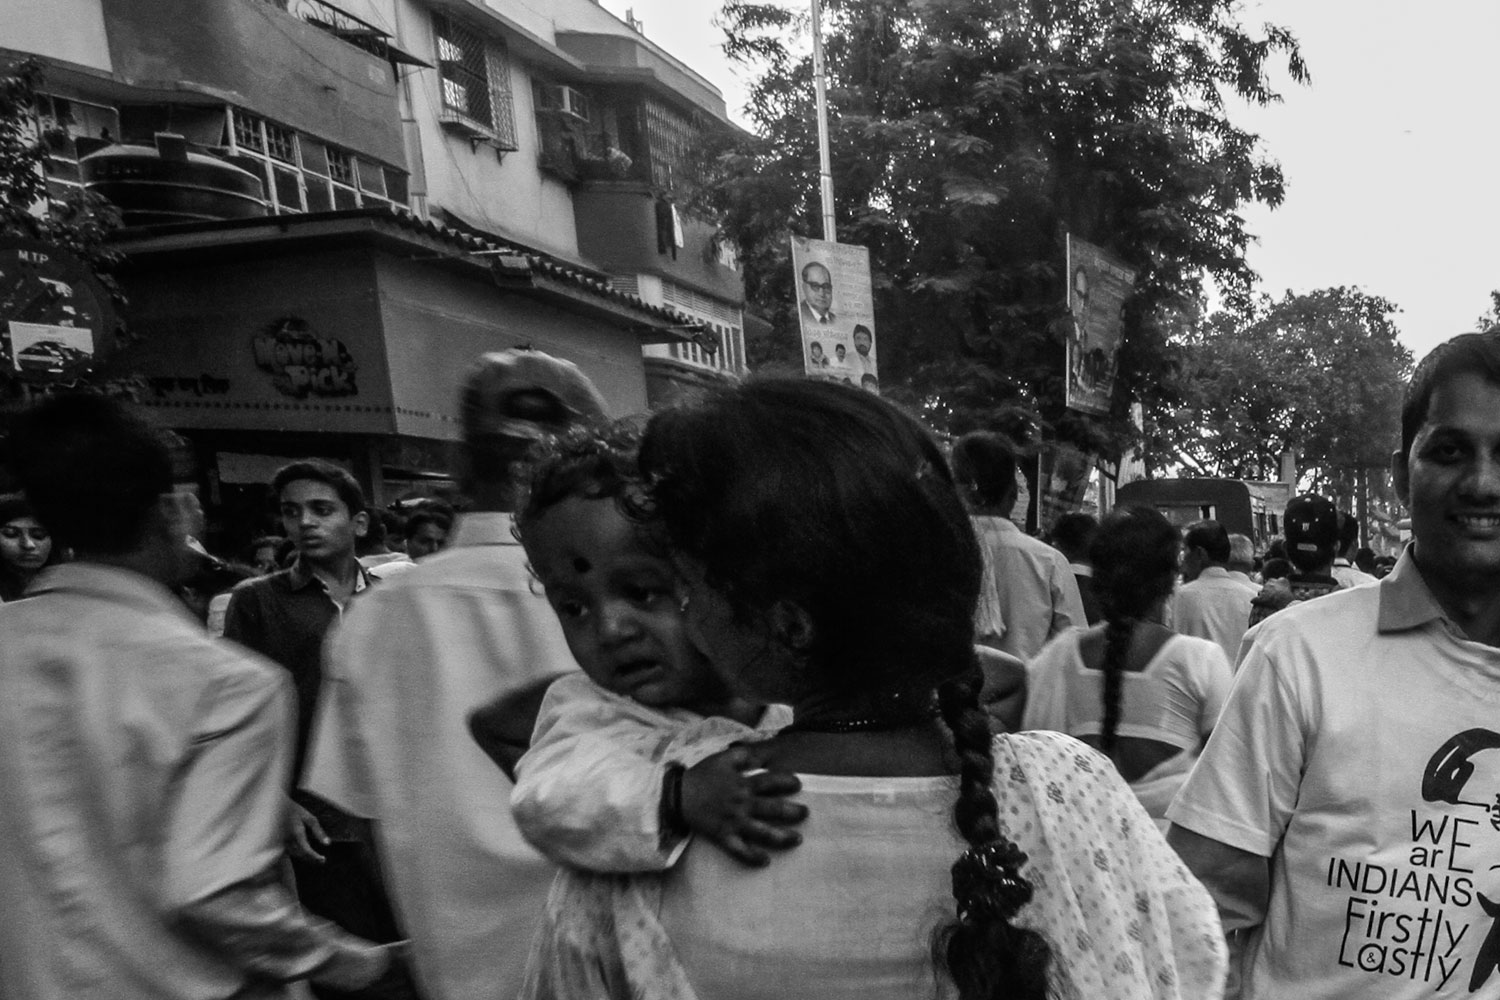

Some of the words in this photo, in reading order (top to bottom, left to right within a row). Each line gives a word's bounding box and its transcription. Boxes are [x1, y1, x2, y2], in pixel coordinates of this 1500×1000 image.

[284, 364, 348, 391] Pick
[1411, 809, 1479, 873] WE
[1327, 857, 1473, 907] INDIANS
[1347, 897, 1469, 957] Firstly
[1339, 942, 1462, 991] Lastly
